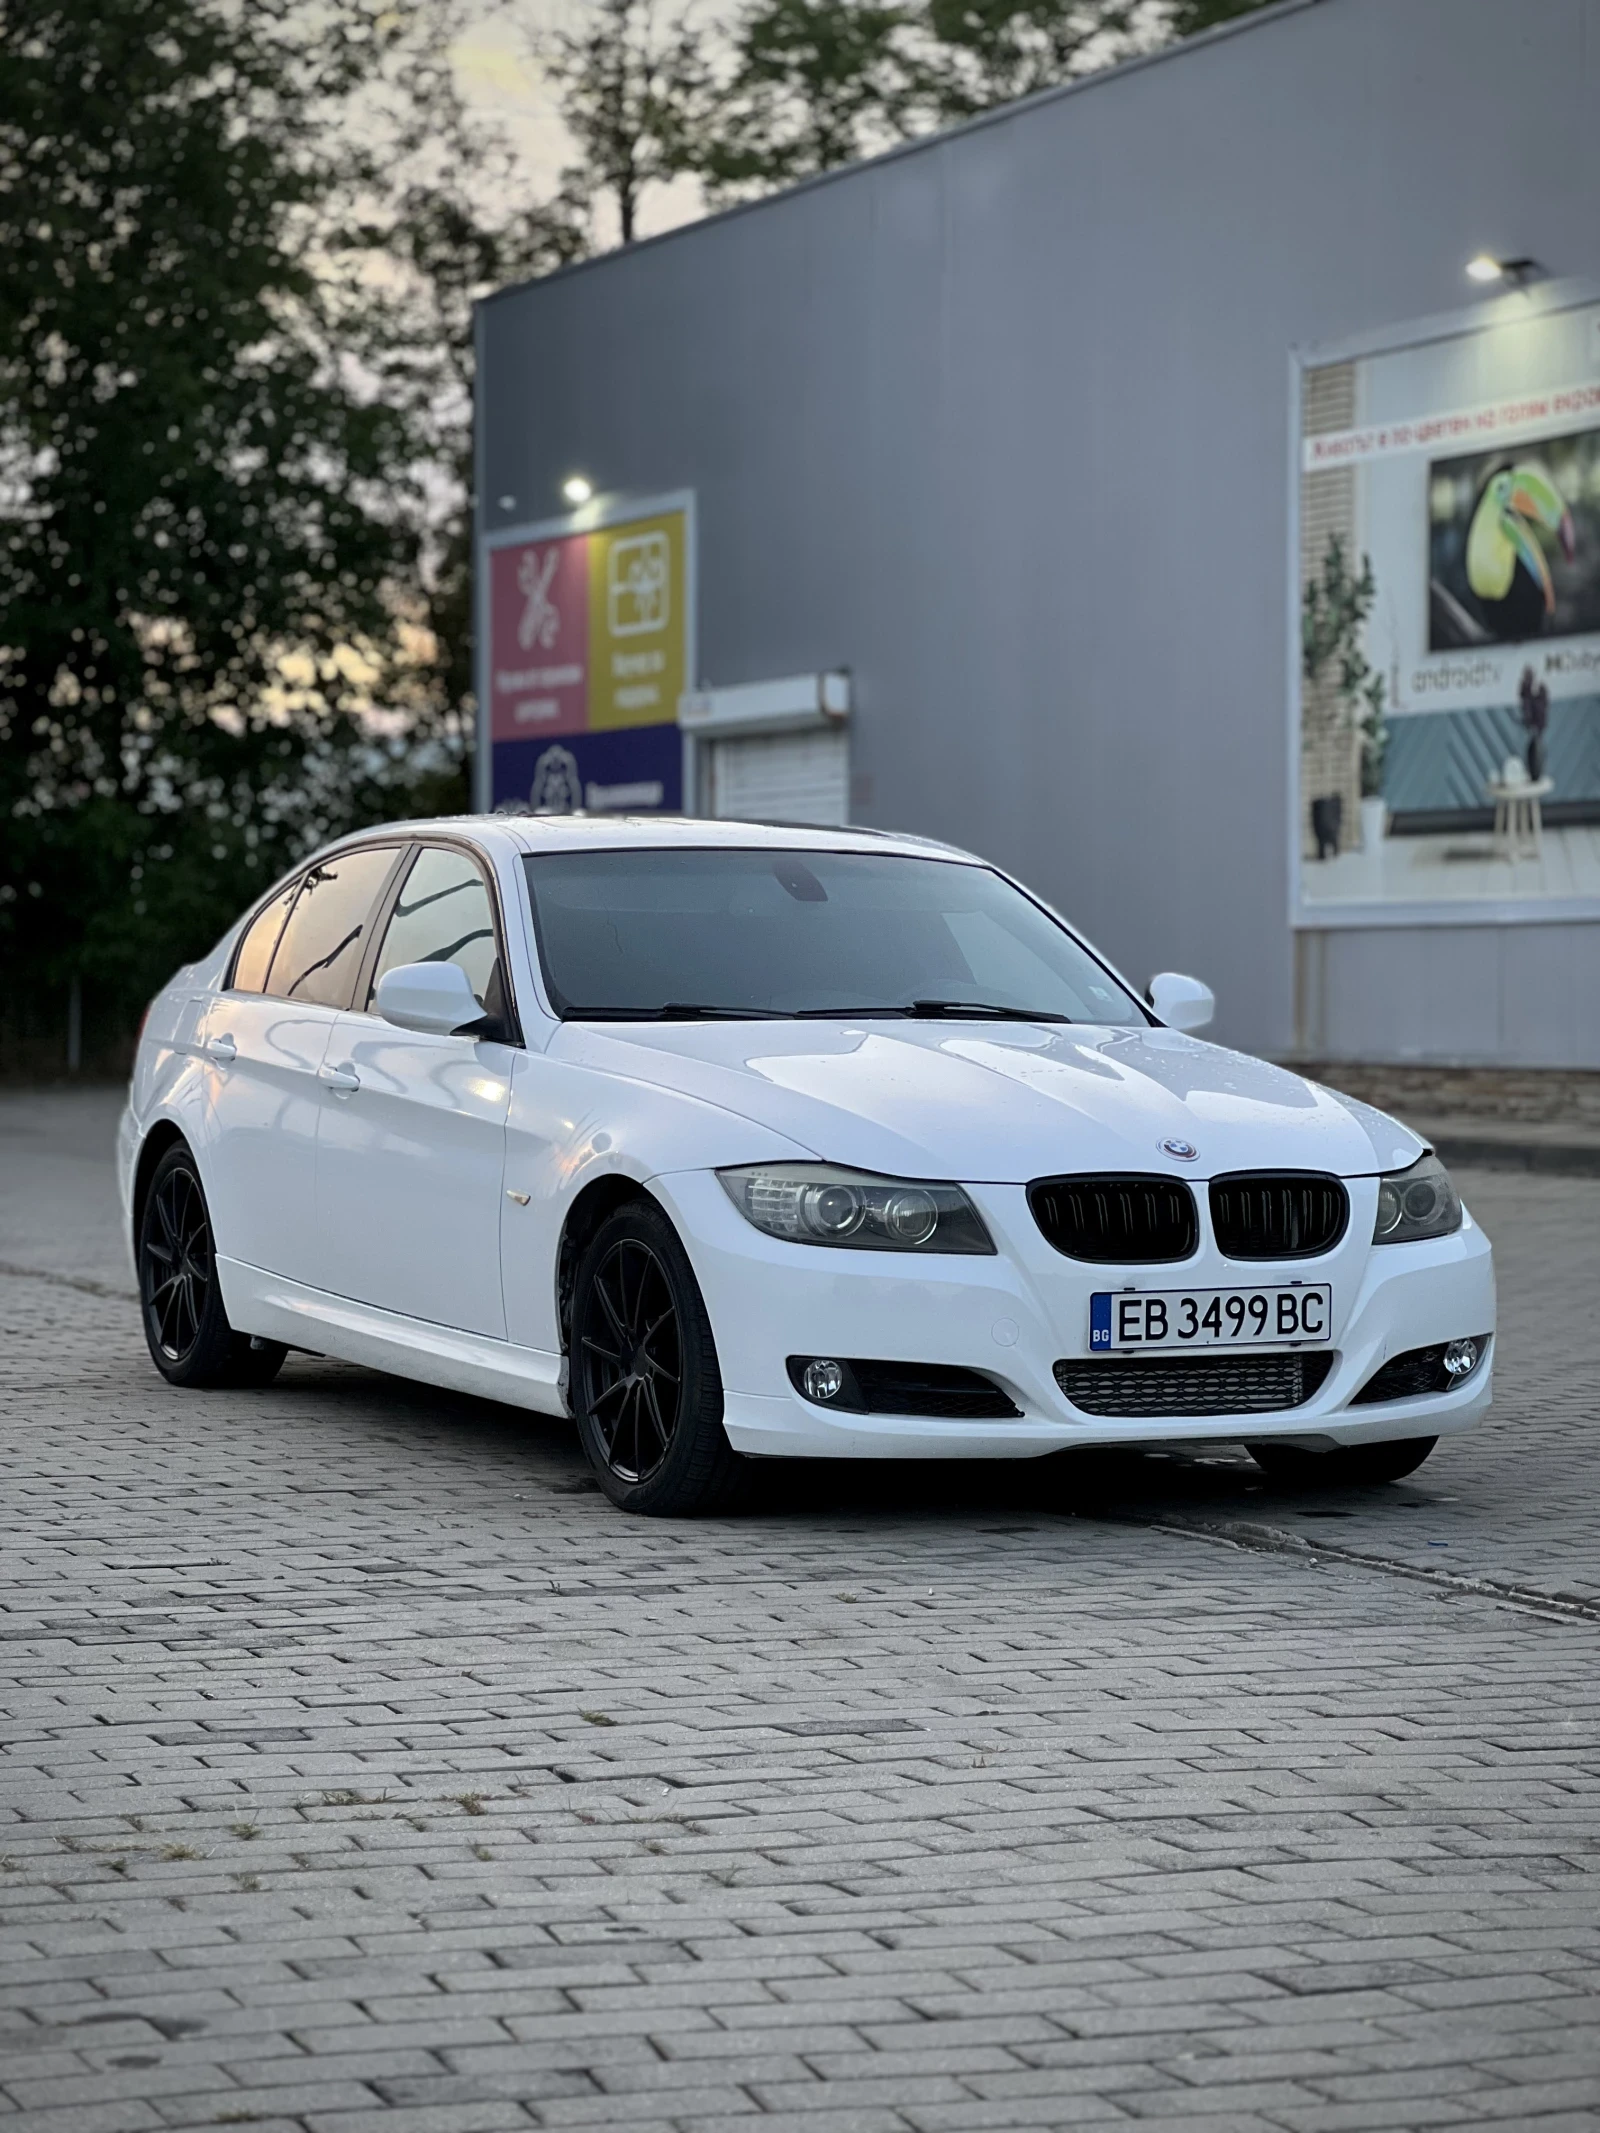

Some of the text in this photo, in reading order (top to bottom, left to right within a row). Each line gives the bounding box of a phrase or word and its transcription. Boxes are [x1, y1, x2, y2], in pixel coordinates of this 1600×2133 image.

[1118, 1292, 1324, 1342] EB 3499 BC
[1092, 1329, 1110, 1342] BG
